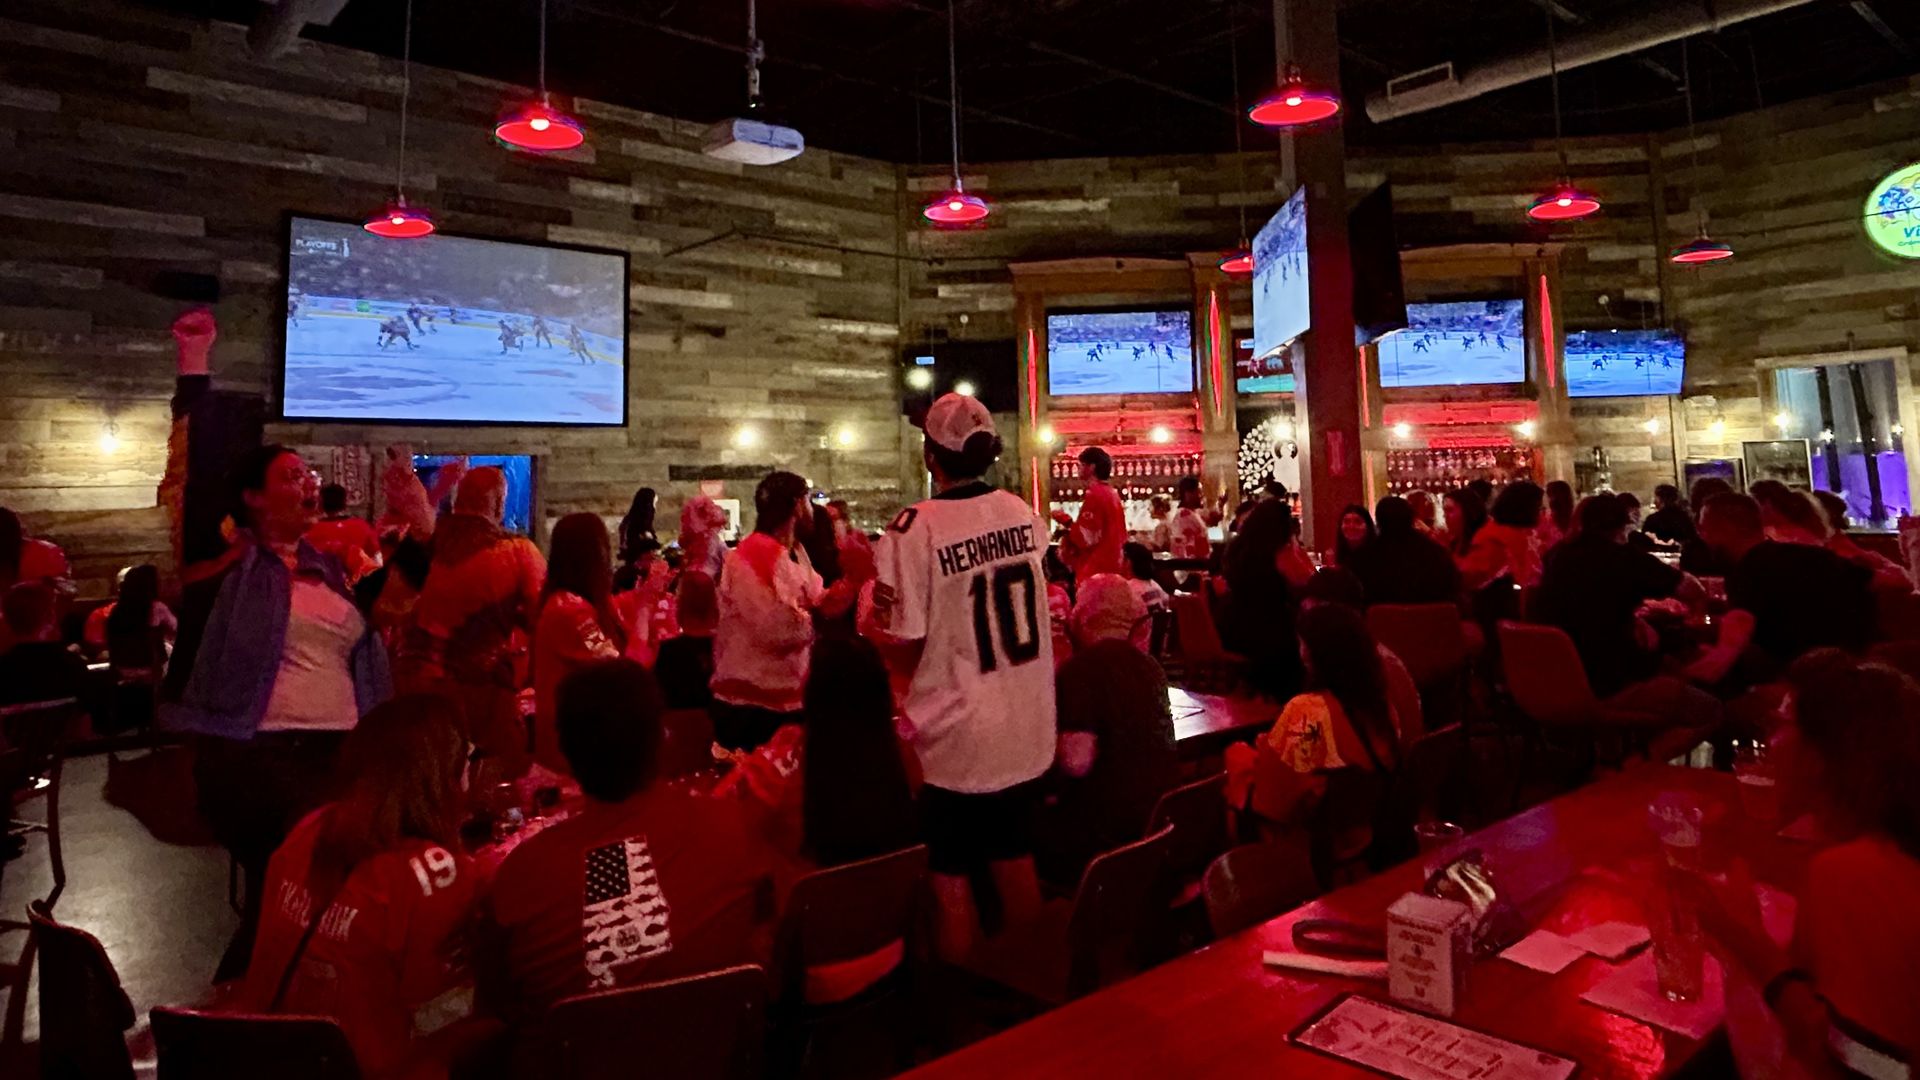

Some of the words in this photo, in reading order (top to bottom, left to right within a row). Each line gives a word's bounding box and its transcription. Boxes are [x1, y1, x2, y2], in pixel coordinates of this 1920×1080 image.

[295, 239, 337, 250] PLAYOFFS
[968, 561, 1040, 675] 10
[408, 846, 457, 897] 19
